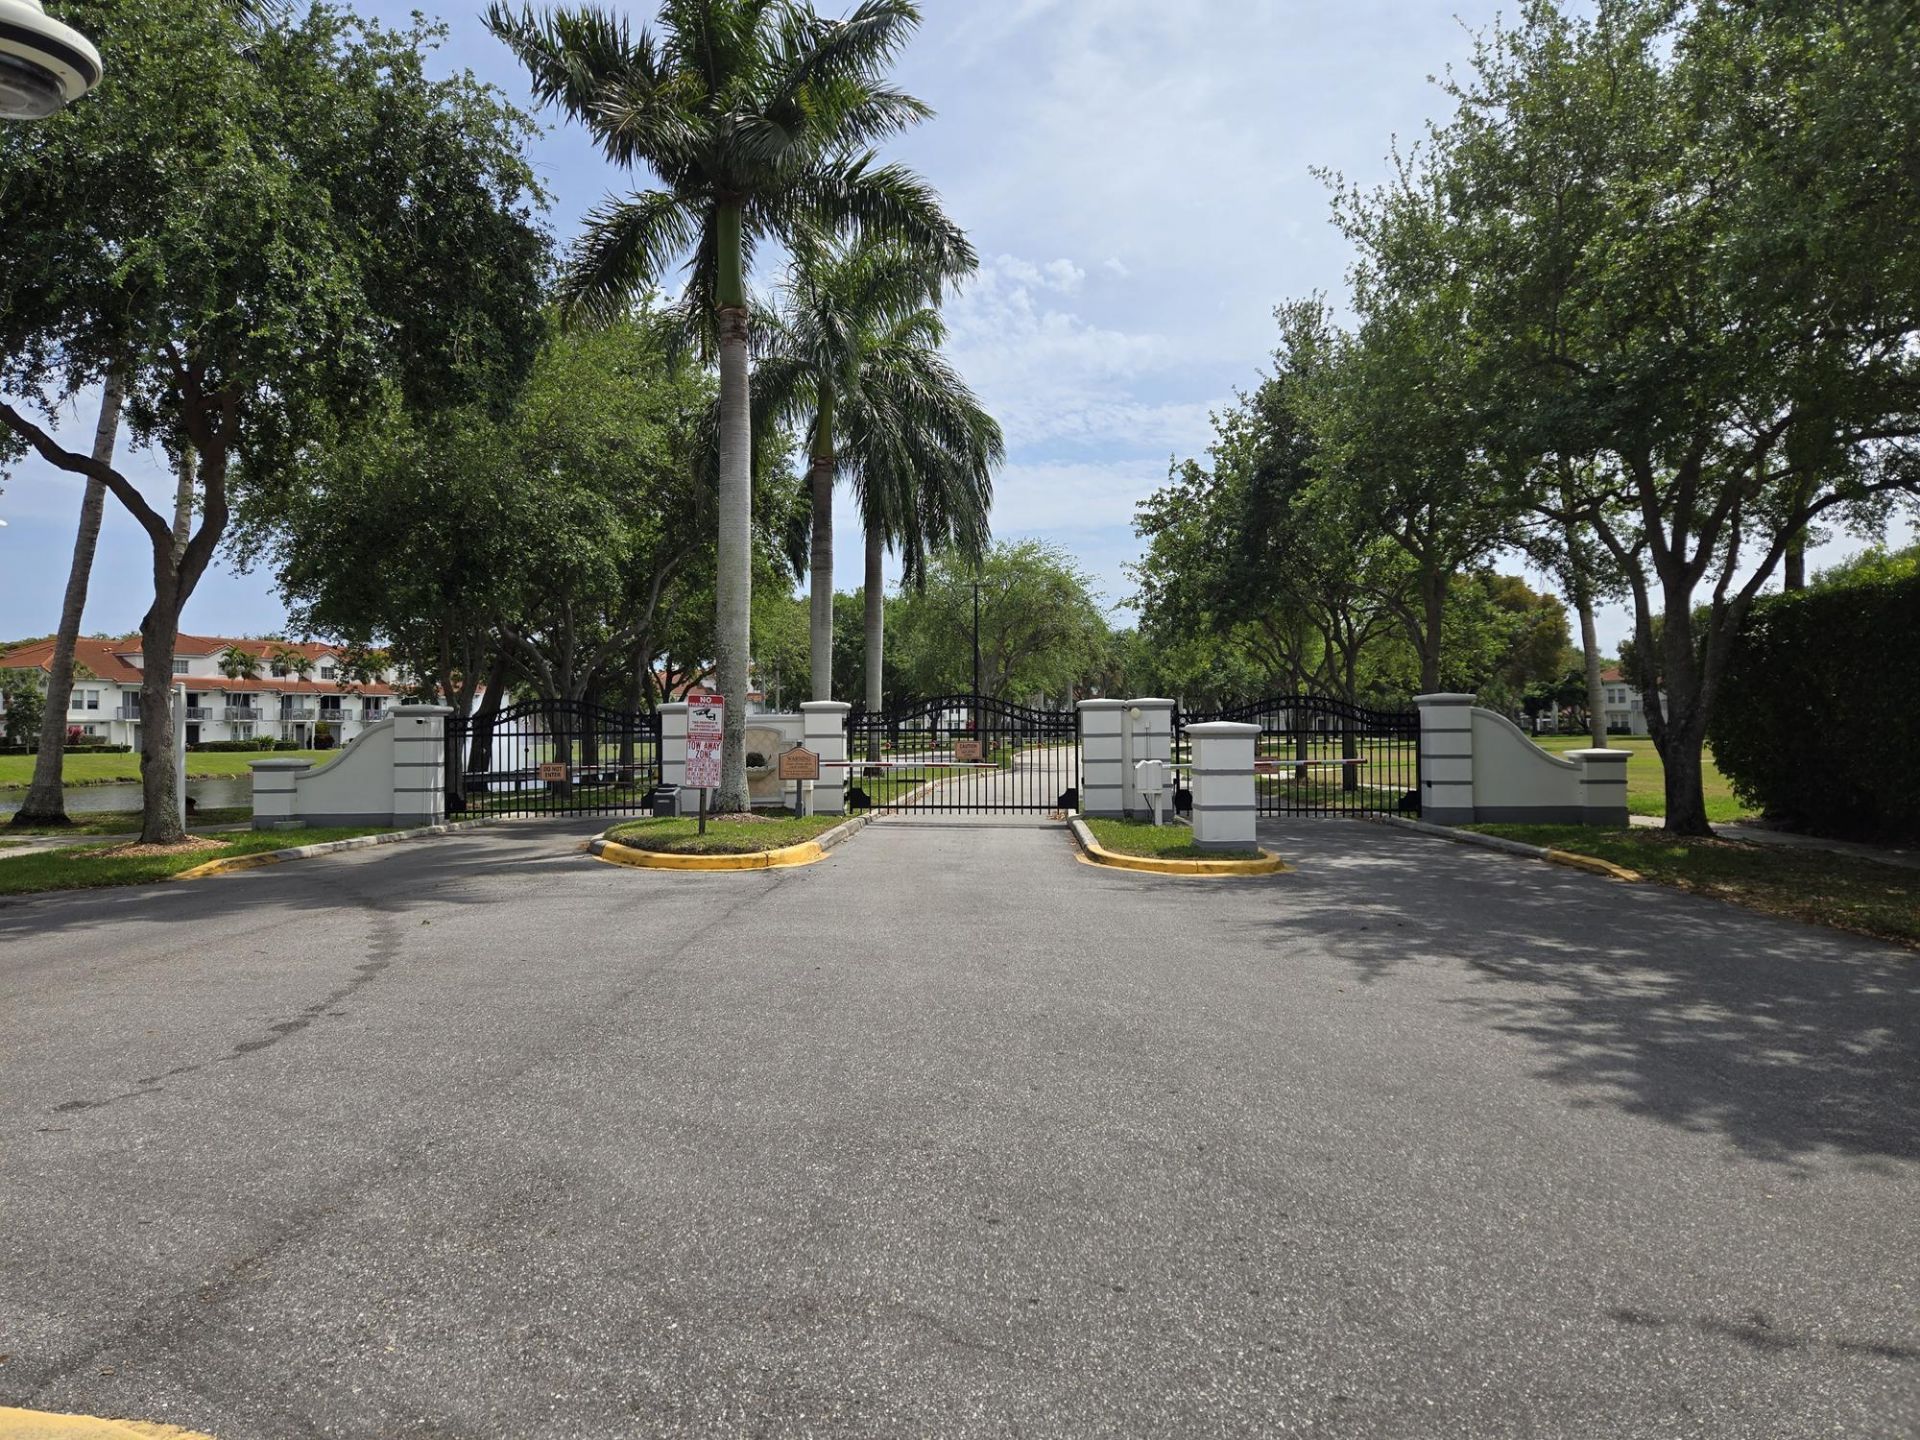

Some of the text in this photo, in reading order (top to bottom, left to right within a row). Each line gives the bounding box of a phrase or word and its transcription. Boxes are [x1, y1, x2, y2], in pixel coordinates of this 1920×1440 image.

[688, 741, 720, 750] TOW AWAY
[696, 750, 712, 758] ZONE
